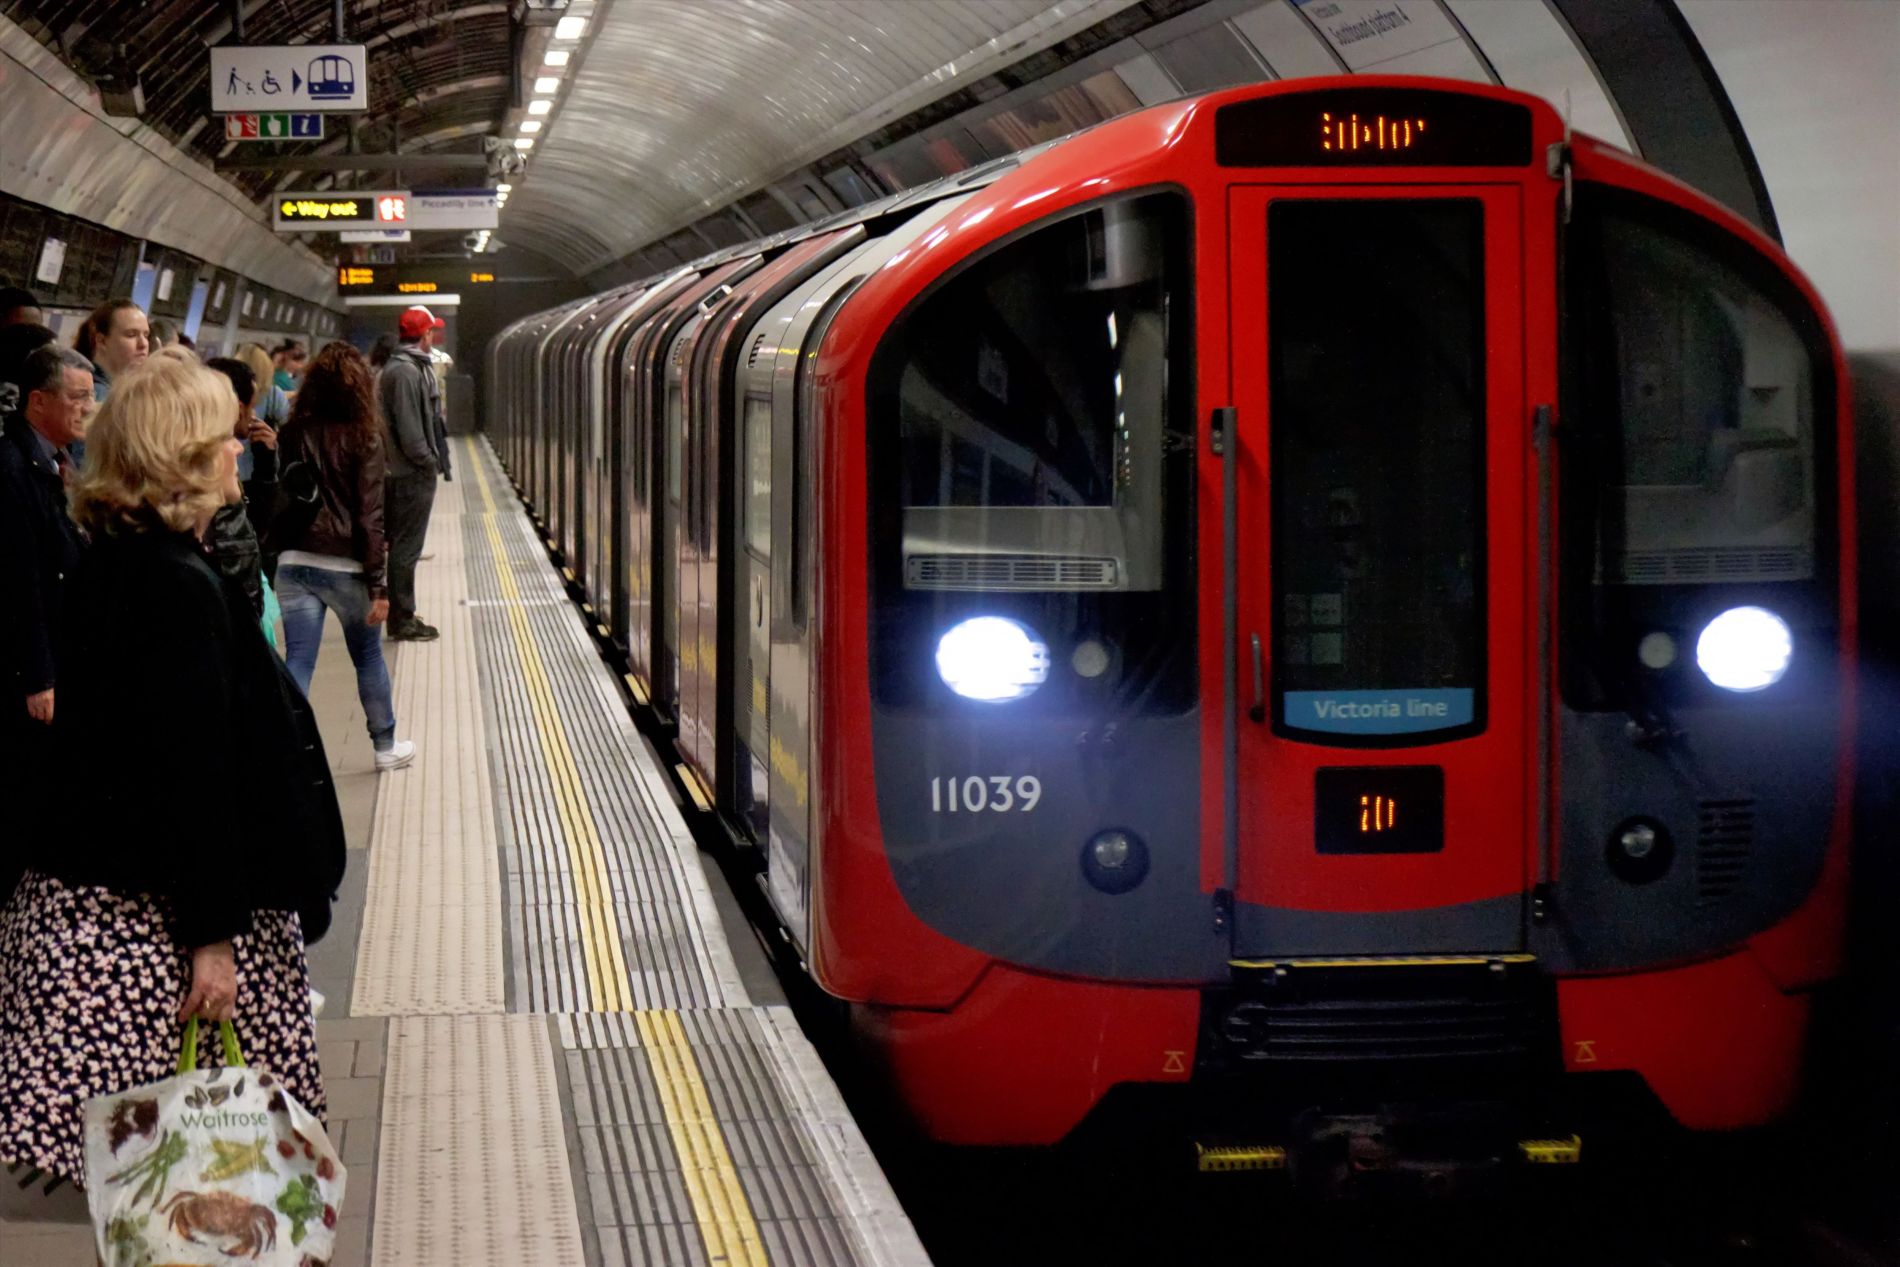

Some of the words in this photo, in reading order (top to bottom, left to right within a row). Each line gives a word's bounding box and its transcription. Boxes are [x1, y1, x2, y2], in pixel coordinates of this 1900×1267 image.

[296, 201, 329, 218] Way
[330, 202, 358, 216] out
[422, 199, 465, 209] Piccadilly
[467, 199, 485, 208] line
[1313, 699, 1401, 719] Victoria
[1406, 698, 1448, 717] line
[932, 775, 1042, 812] 11039
[179, 1109, 269, 1130] Waitrose
